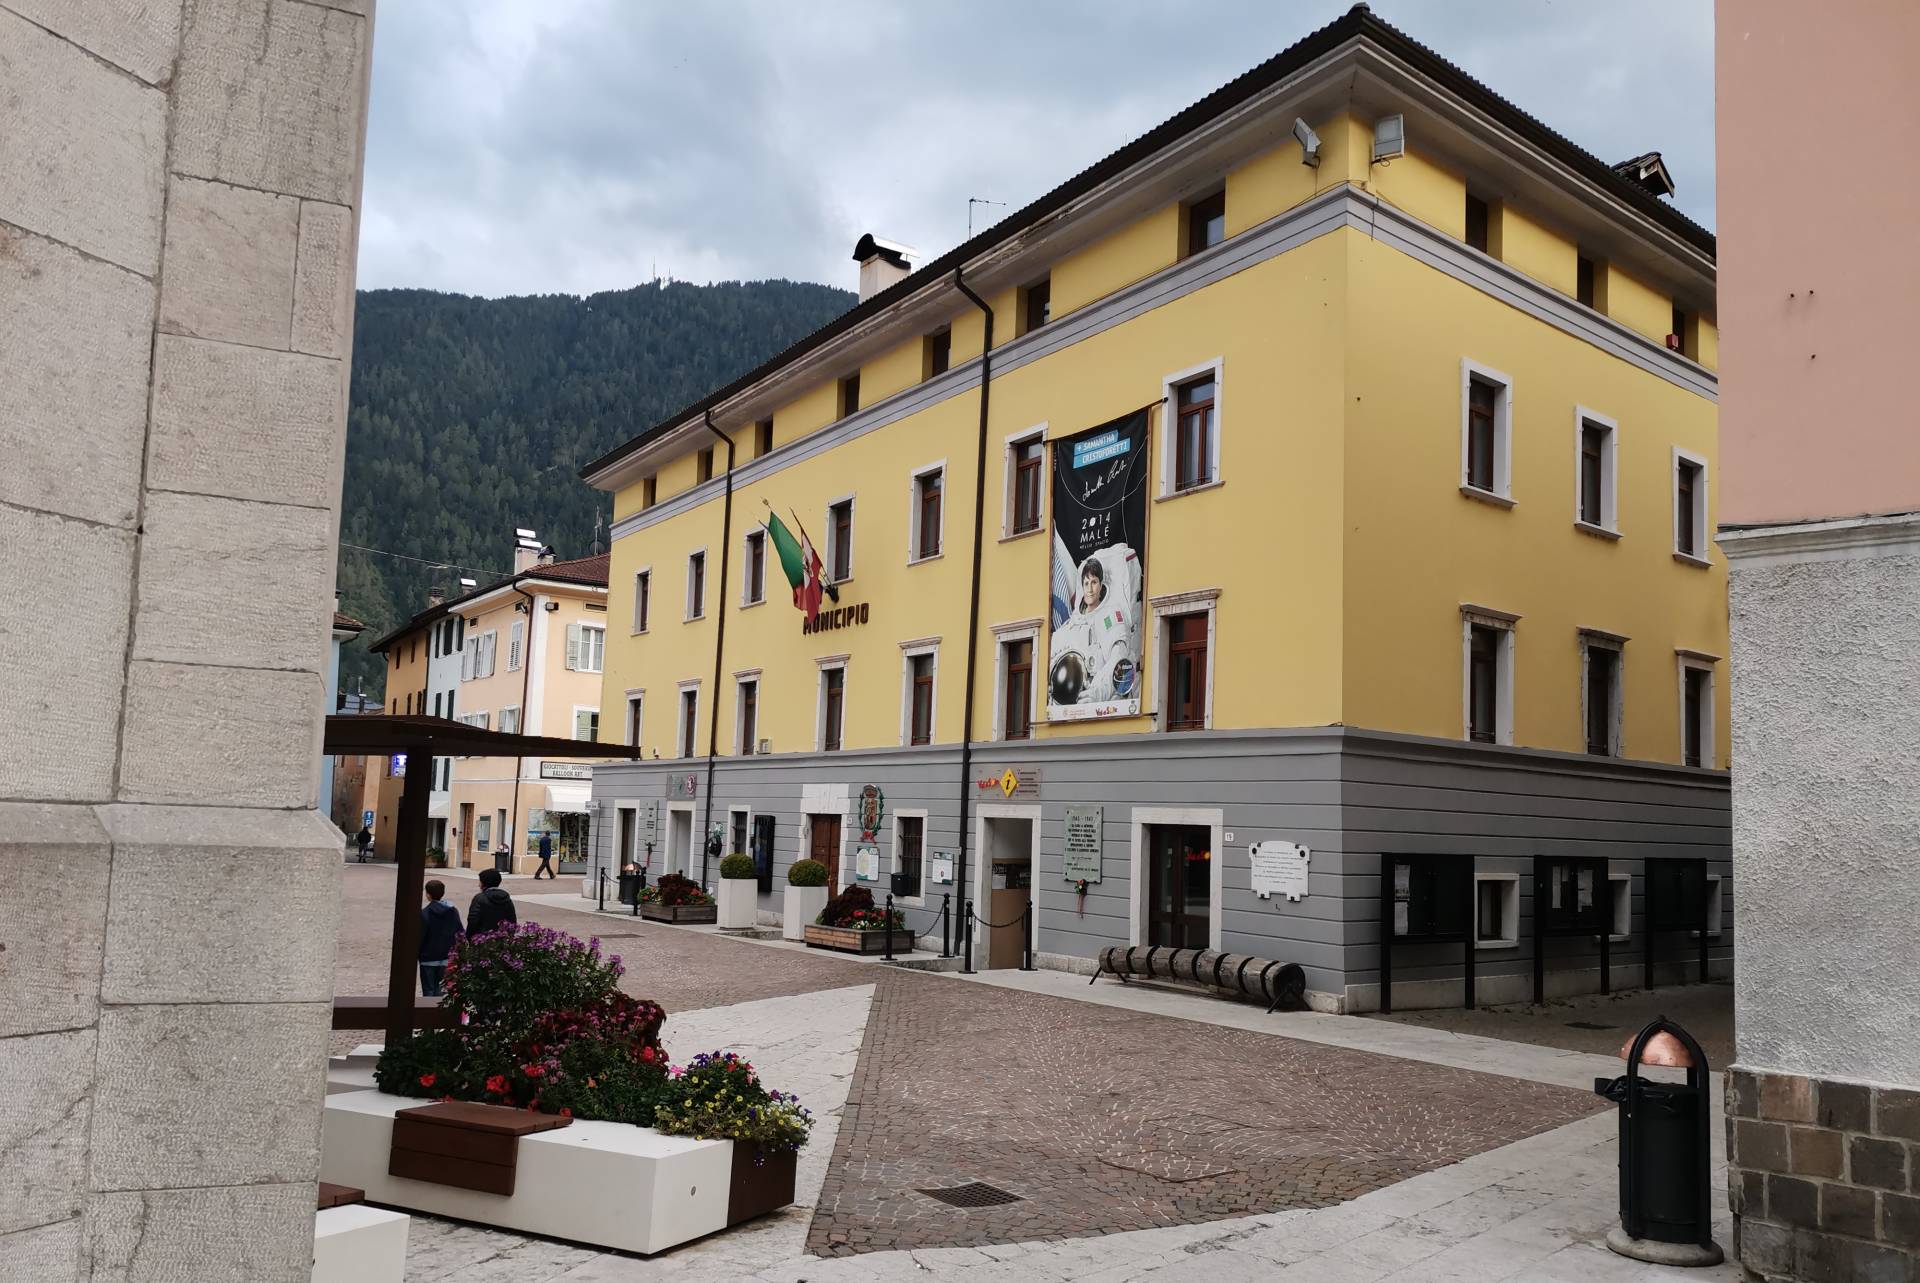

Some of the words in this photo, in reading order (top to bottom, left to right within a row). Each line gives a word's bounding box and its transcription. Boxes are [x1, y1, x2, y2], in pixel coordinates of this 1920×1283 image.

[1083, 432, 1115, 451] SAMANTHA
[1082, 441, 1127, 464] CRISTOFORETTI
[1081, 511, 1111, 530] 2014
[803, 602, 869, 636] MUNICIPIO
